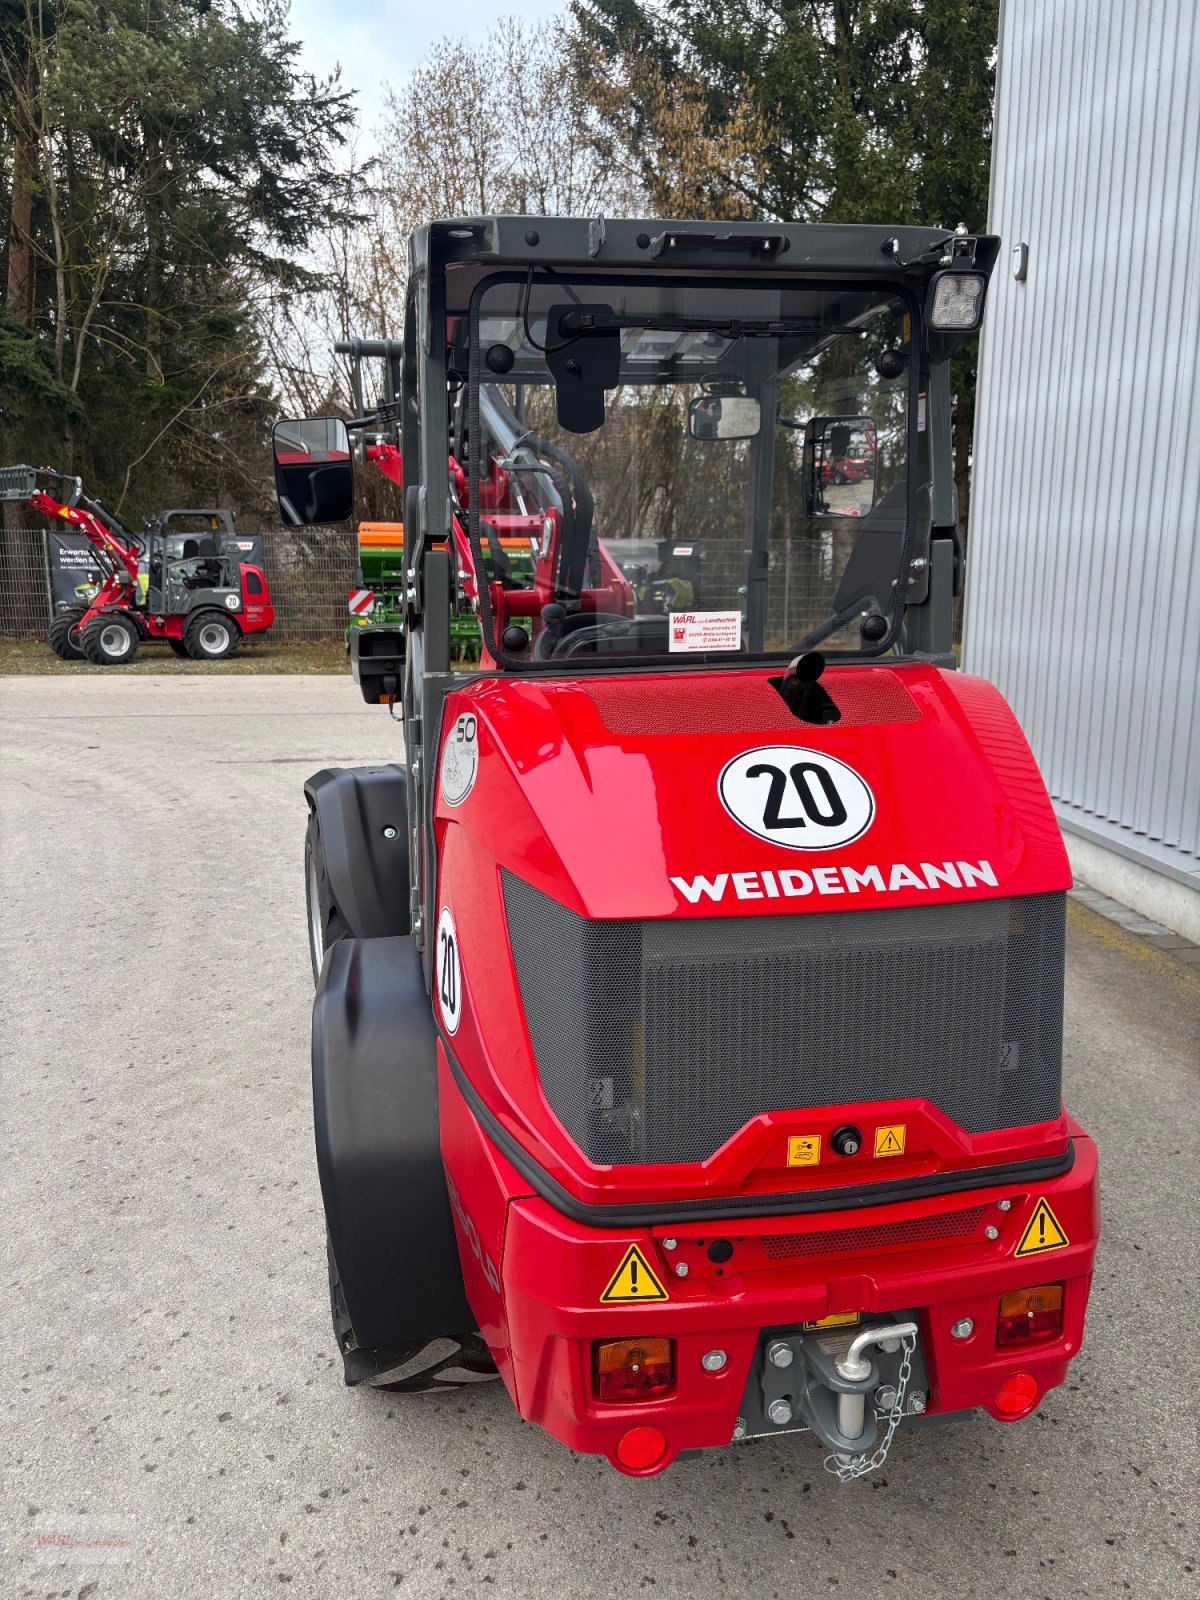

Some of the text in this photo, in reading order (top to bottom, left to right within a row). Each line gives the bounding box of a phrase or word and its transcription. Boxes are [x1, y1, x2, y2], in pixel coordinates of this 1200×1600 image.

[228, 597, 236, 606] 20
[673, 614, 697, 624] WÄRL
[457, 717, 476, 742] 50
[746, 762, 847, 829] 20
[670, 860, 998, 903] WEIDEMANN
[442, 927, 456, 1014] 20
